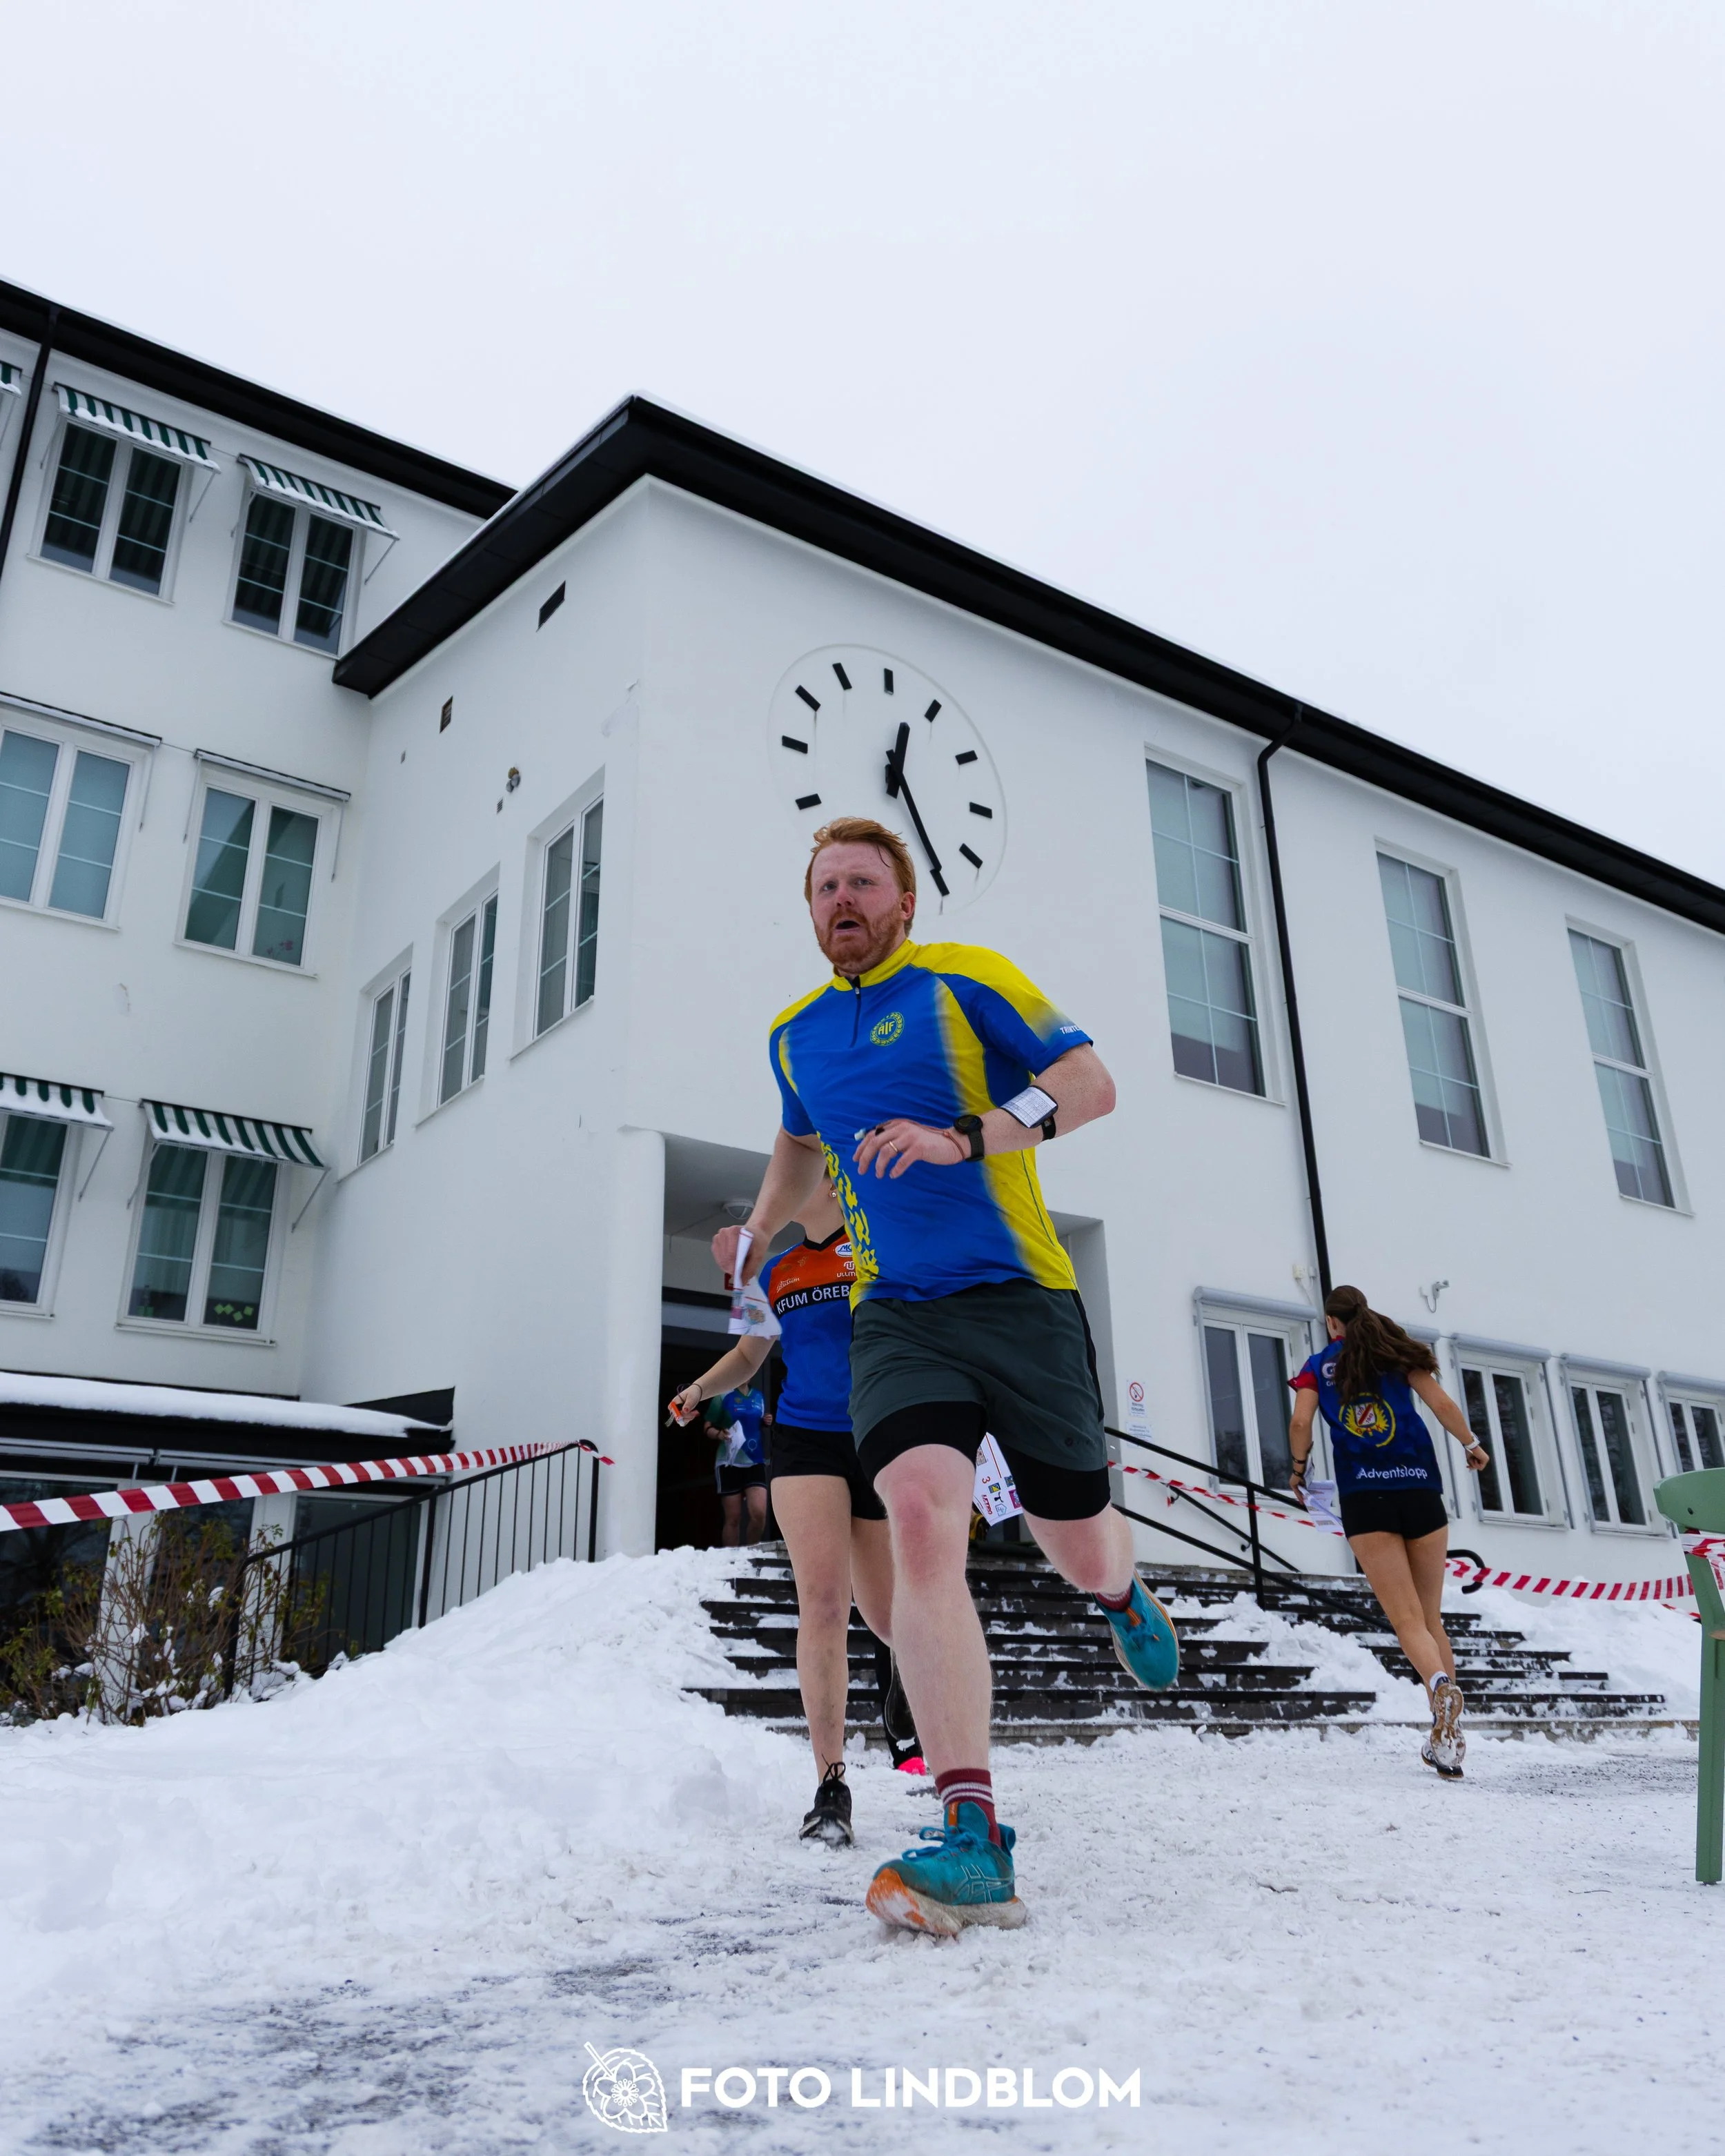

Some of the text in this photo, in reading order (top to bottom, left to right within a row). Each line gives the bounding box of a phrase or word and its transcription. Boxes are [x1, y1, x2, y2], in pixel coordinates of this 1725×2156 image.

[776, 1287, 849, 1314] KFUM ÖREB
[982, 1476, 991, 1484] 3
[1357, 1465, 1428, 1480] Adventslopp
